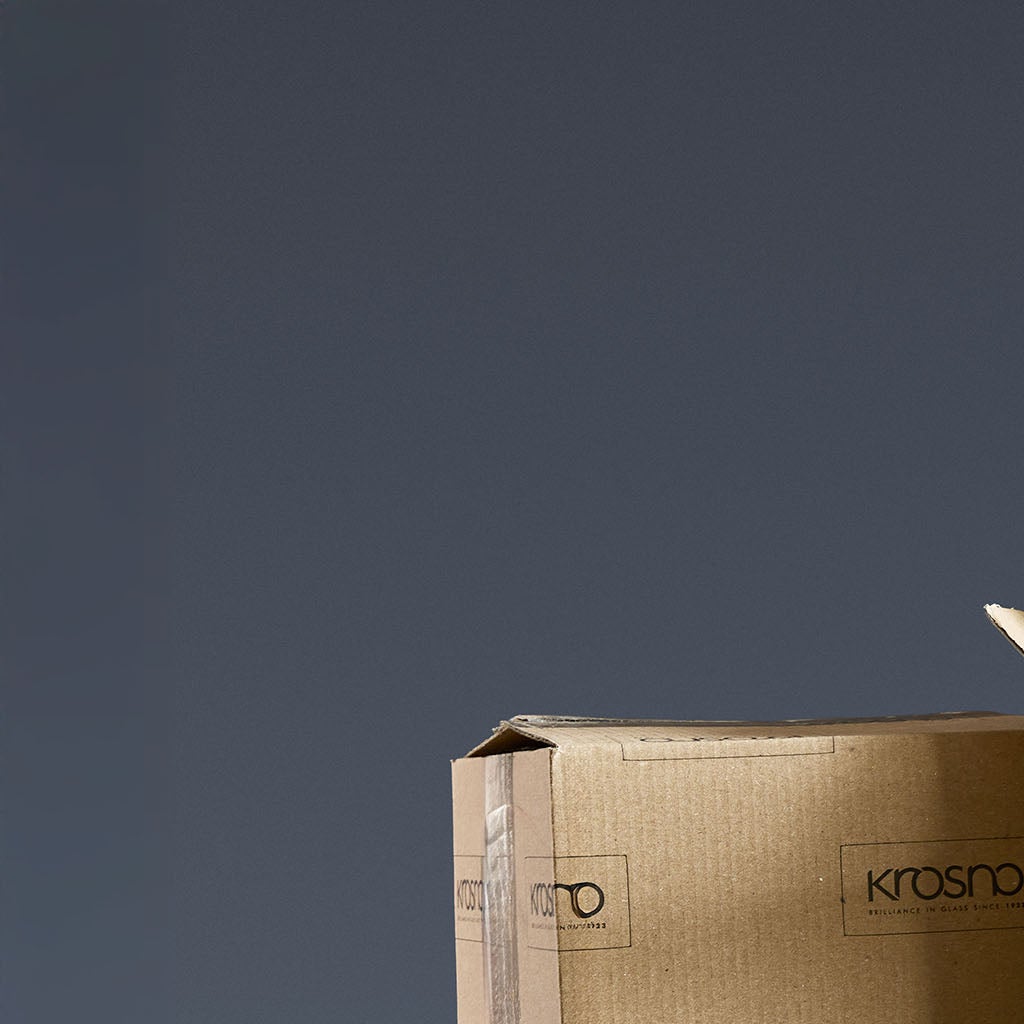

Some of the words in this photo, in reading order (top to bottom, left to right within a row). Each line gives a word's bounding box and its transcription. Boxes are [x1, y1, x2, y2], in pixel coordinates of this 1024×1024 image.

[868, 907, 921, 916] BRILLIANCE
[926, 905, 936, 913] IN
[941, 904, 969, 913] GLASS
[974, 903, 1000, 911] SINCE
